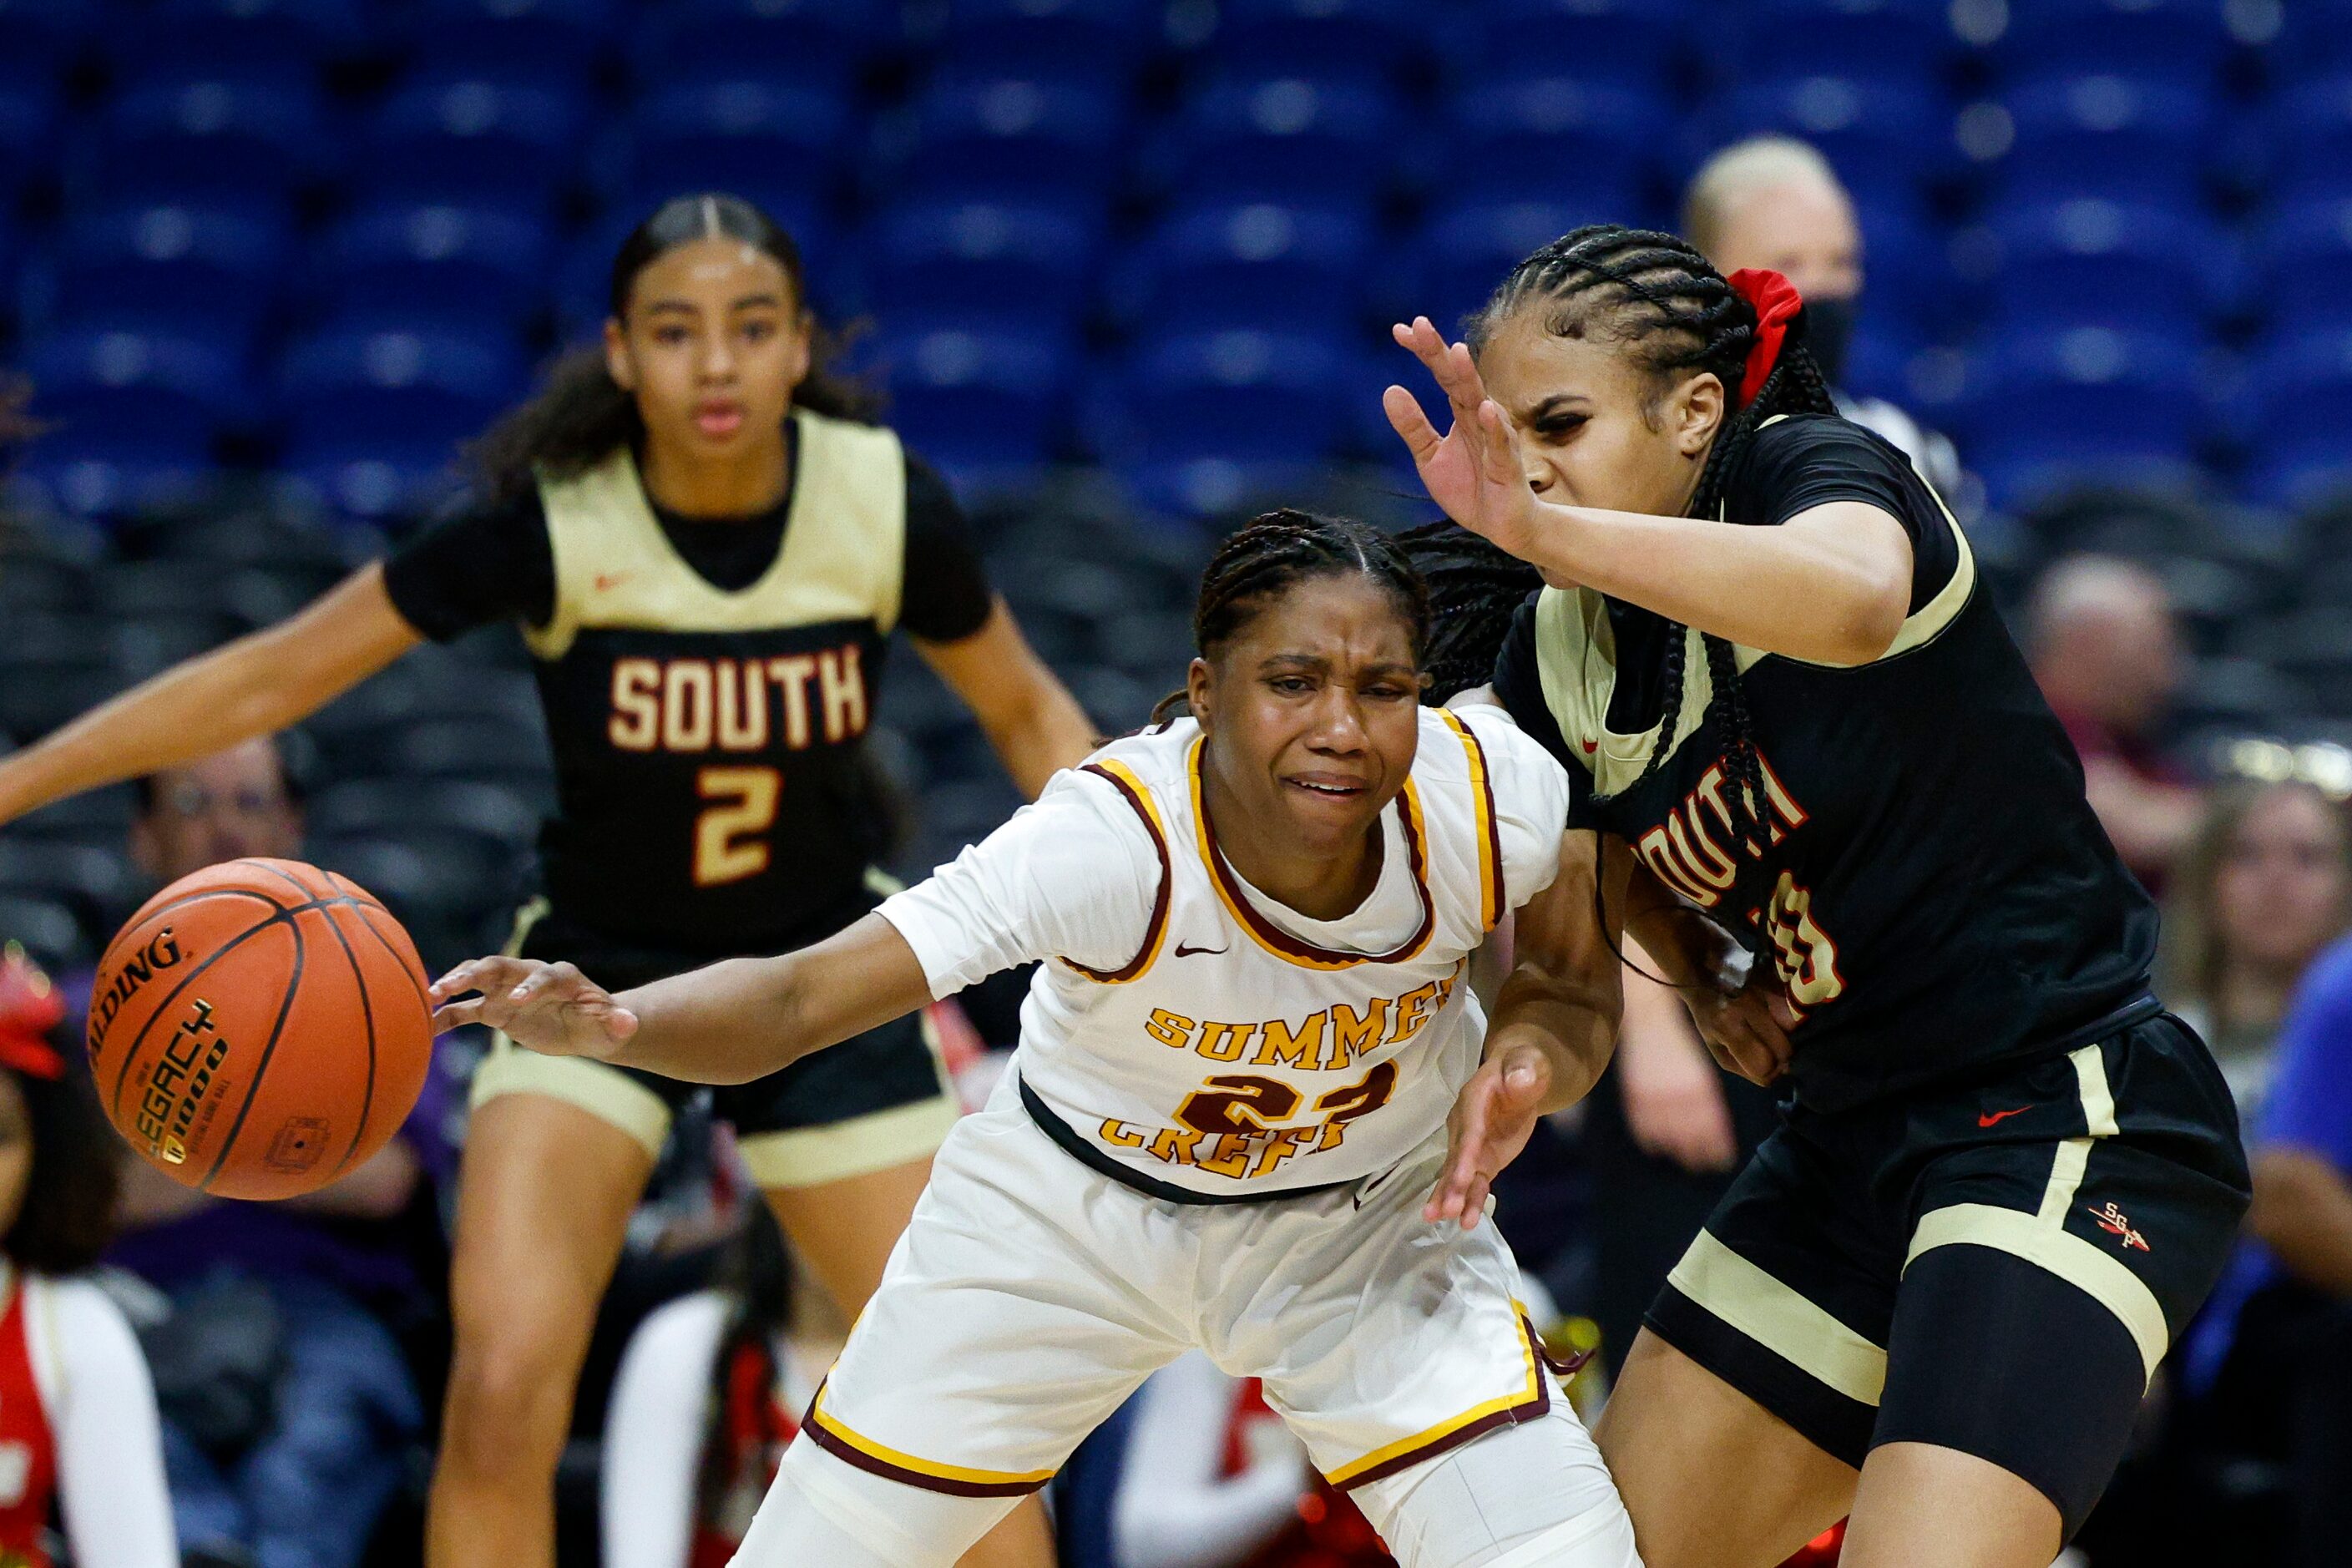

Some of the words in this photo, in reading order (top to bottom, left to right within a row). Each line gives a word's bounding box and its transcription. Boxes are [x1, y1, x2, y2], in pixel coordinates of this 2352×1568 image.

[609, 643, 867, 751] SOUTH
[691, 765, 783, 888] 2
[1630, 740, 1809, 908] OUTH
[88, 926, 181, 1062] ALDING
[136, 999, 214, 1146] EGACY
[173, 1038, 229, 1136] 1000
